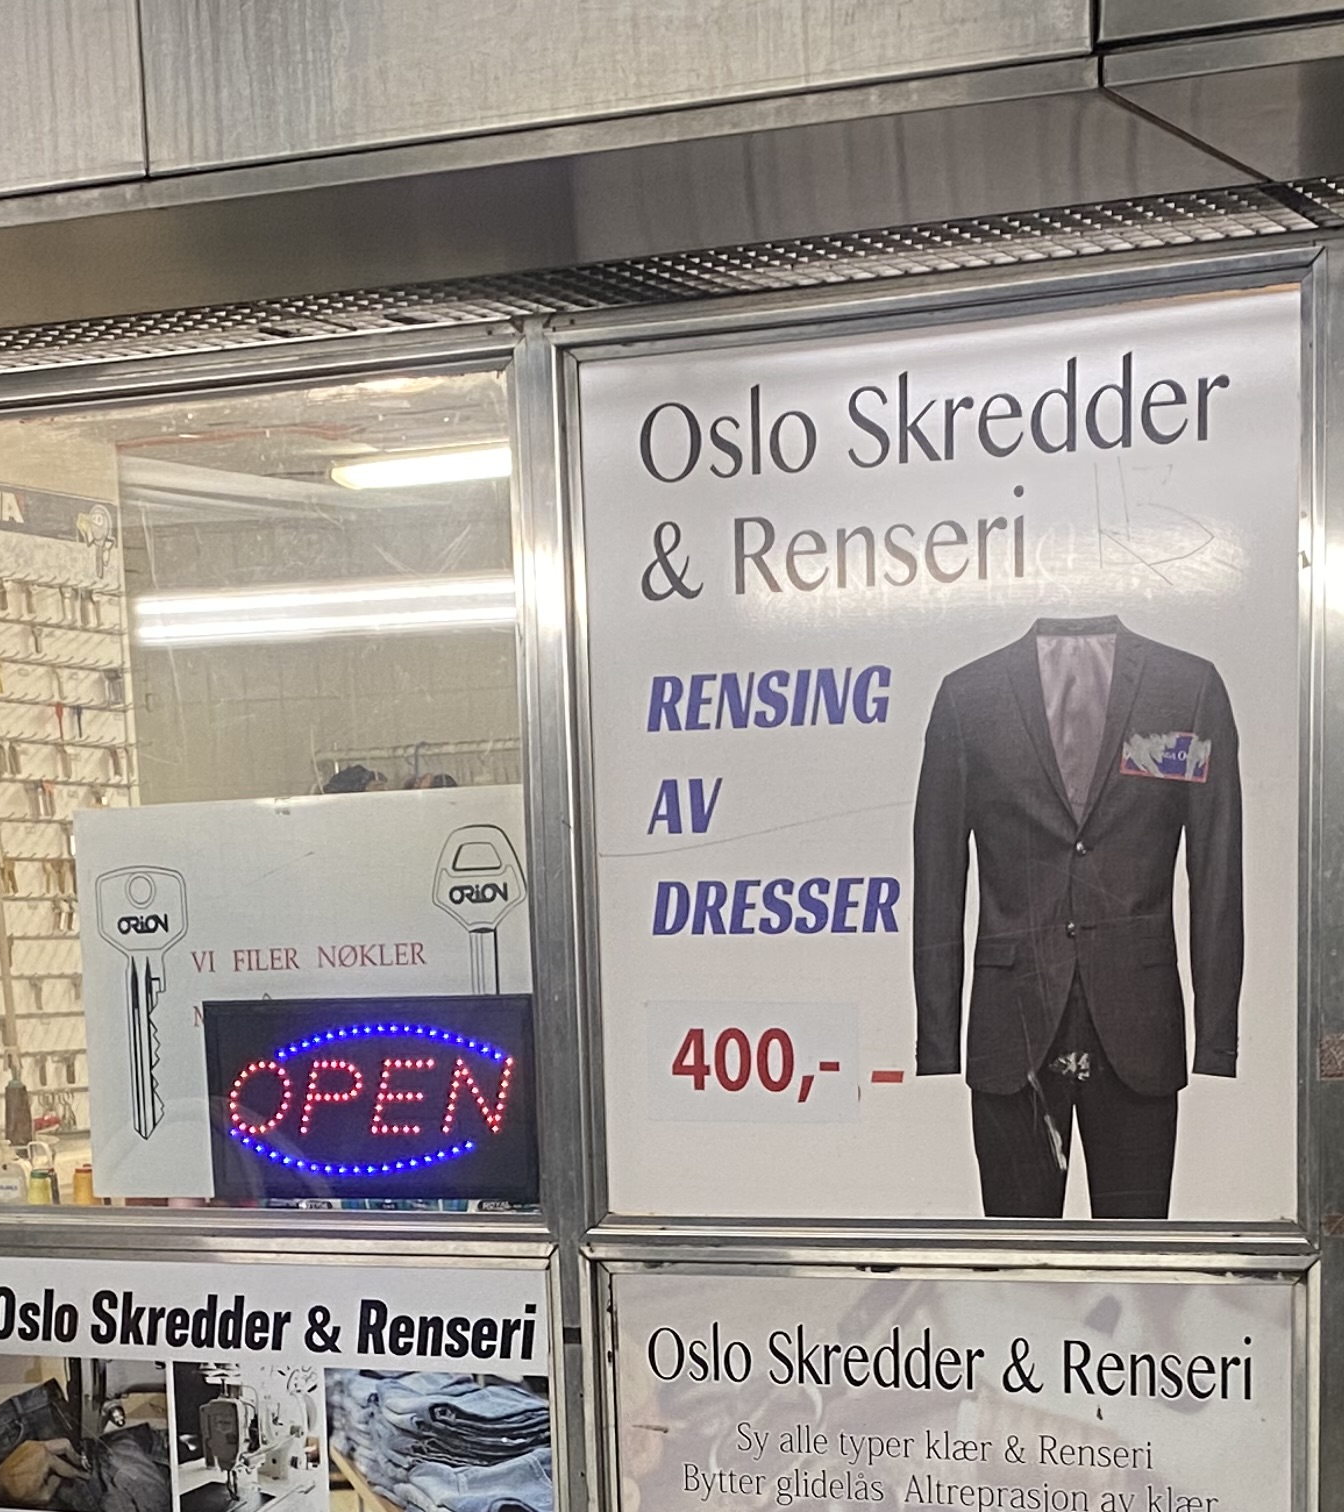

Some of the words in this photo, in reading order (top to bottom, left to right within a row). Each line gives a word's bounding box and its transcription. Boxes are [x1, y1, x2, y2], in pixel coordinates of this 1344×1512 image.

[638, 385, 817, 484] Oslo
[846, 351, 1231, 469] Skredder
[641, 520, 704, 601] &
[734, 484, 1026, 595] Renseri
[647, 665, 891, 733] RENSING
[647, 777, 723, 835] AV
[652, 877, 901, 937] DRESSER
[190, 951, 216, 973] VI
[233, 948, 300, 972] FILER
[318, 942, 426, 968] NØKLER
[229, 1057, 514, 1134] OPEN
[672, 1027, 840, 1103] 400,-
[91, 1290, 292, 1351] Skredder
[305, 1305, 342, 1353] &
[357, 1298, 537, 1361] Renseri
[647, 1321, 752, 1385] Oslo
[768, 1324, 985, 1393] Skredder
[1003, 1337, 1044, 1395] &
[1063, 1335, 1254, 1401] Renseri
[737, 1422, 770, 1460] Sy
[779, 1425, 828, 1456] alle
[838, 1433, 915, 1466] typer
[925, 1430, 993, 1464] klær
[1004, 1435, 1027, 1464] &
[1039, 1435, 1153, 1470] Renseri
[683, 1463, 766, 1502] Bytter
[777, 1469, 885, 1505] glidelås
